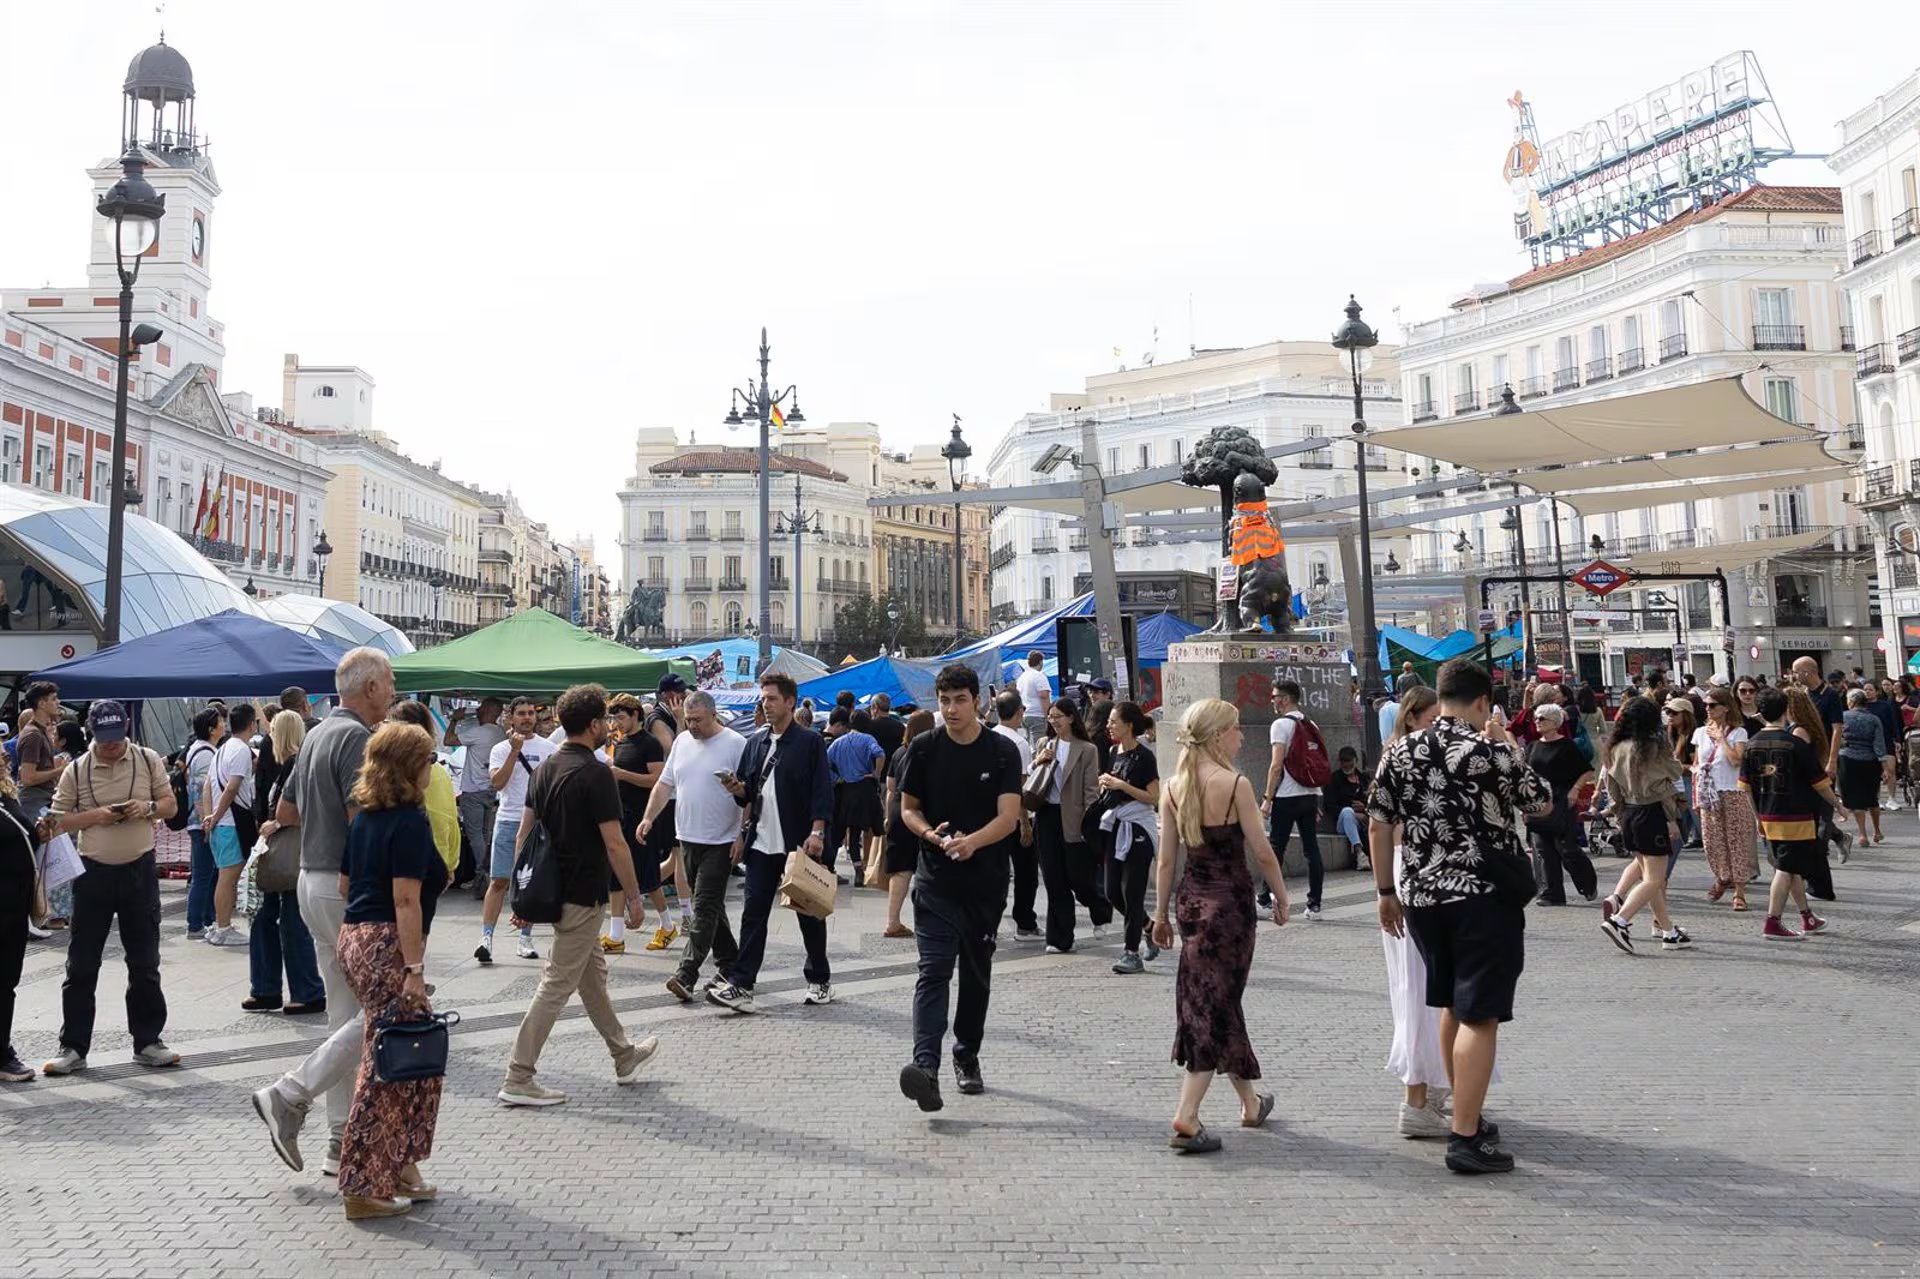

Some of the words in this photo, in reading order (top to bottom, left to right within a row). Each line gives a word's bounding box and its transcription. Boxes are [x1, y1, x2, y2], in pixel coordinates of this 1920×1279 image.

[1588, 574, 1613, 582] Metro
[1596, 601, 1609, 609] Sol
[1781, 640, 1829, 649] SEPHORA
[1305, 665, 1345, 686] THE
[1298, 687, 1329, 709] ICH
